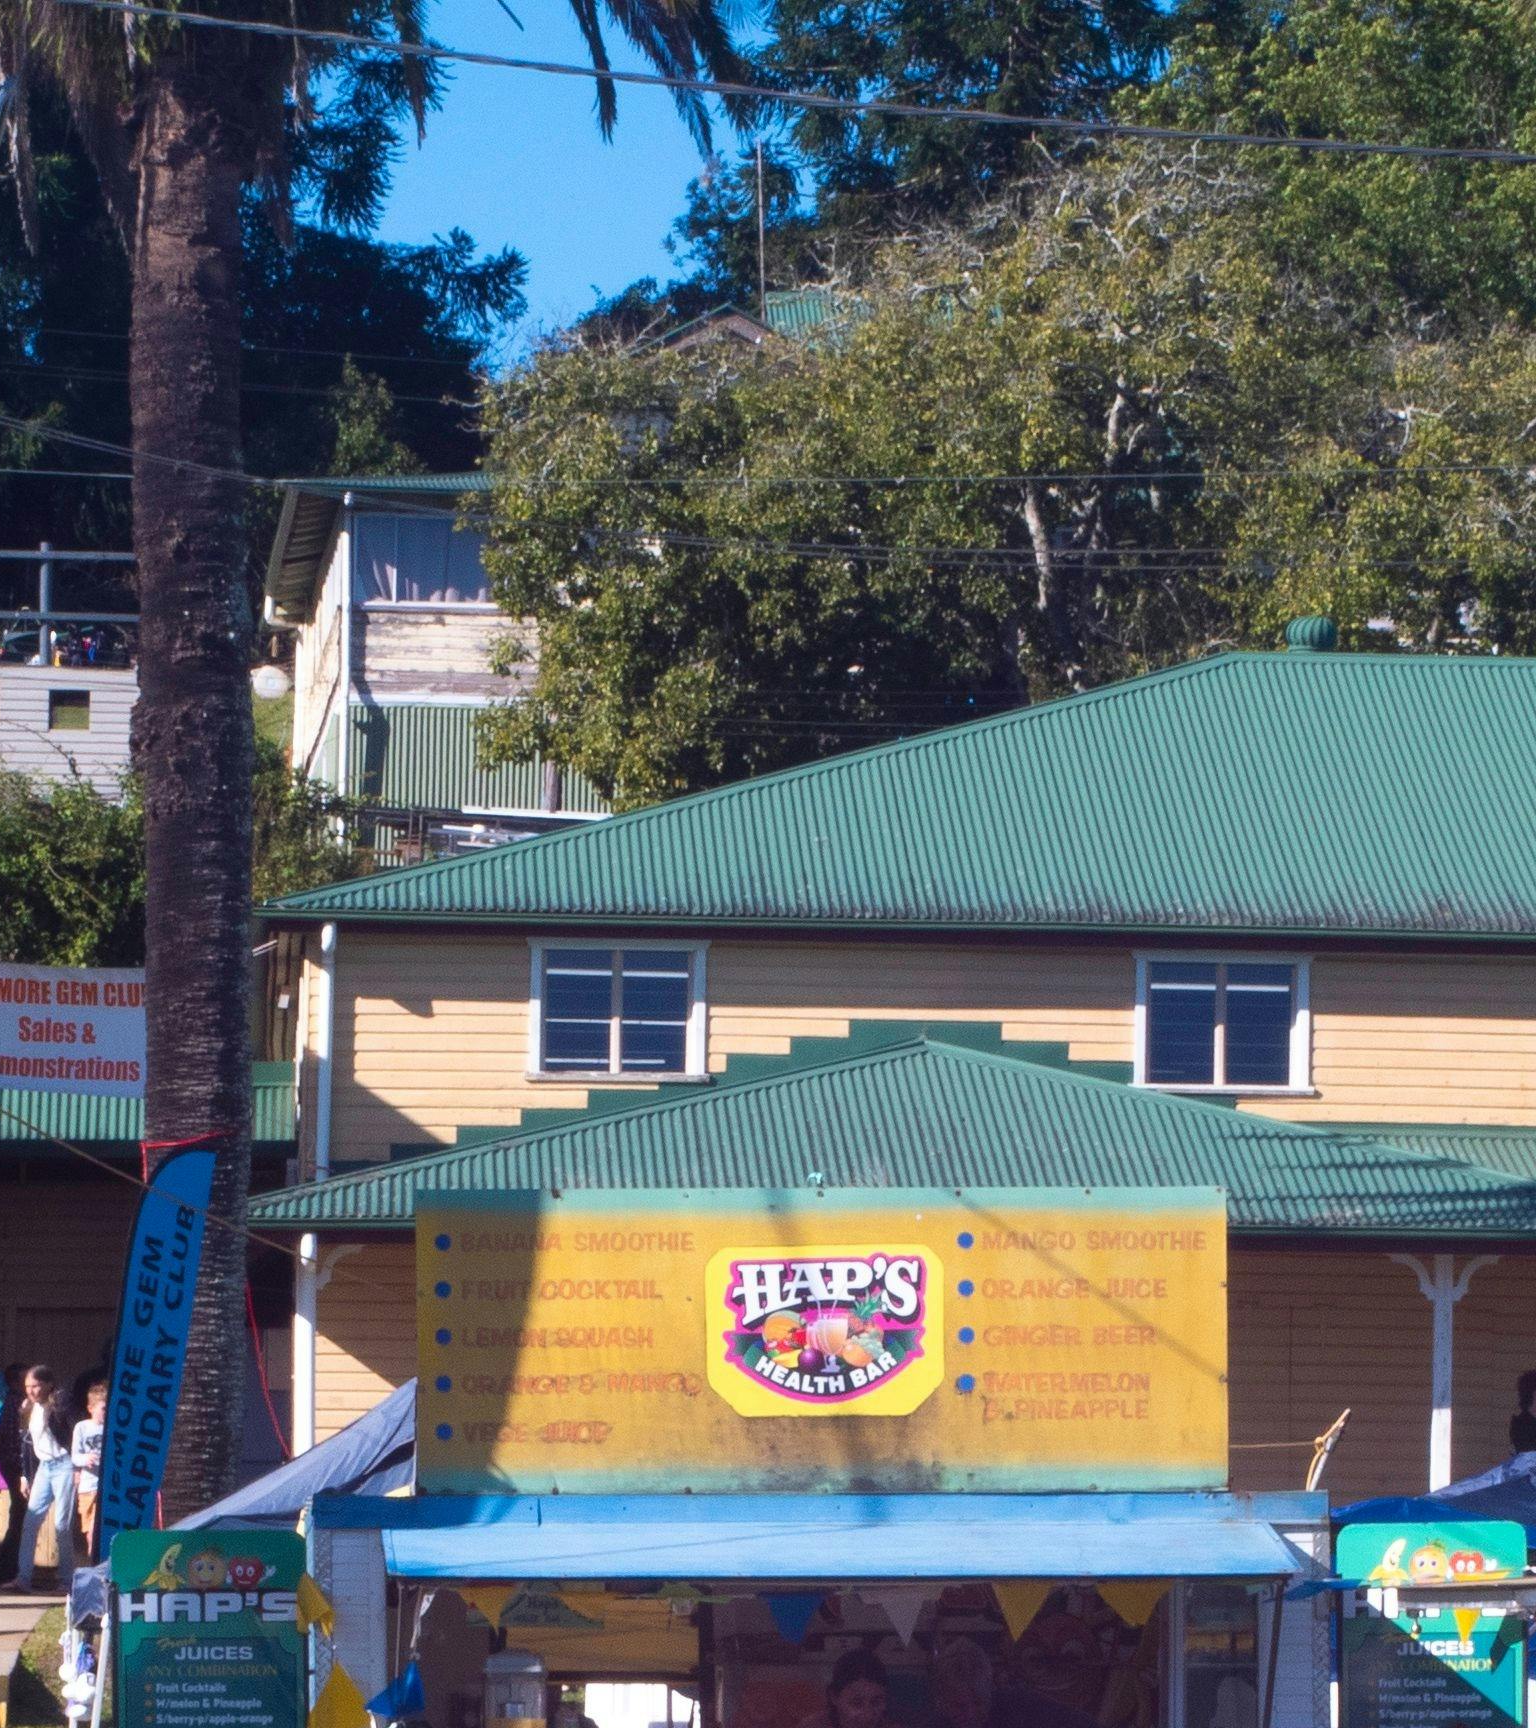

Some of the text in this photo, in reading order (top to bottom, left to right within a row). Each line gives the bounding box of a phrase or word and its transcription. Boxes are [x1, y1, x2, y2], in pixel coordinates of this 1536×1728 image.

[56, 979, 98, 1005] GEM
[104, 982, 147, 1007] CLU
[18, 1015, 96, 1044] Sales &
[574, 1231, 695, 1252] SMOOTHIE
[981, 1229, 1208, 1250] MANGO SMOOTHIE
[165, 1204, 197, 1311] CLUB
[134, 1236, 164, 1327] GEM
[541, 1278, 663, 1301] COCKTAIL
[731, 1256, 920, 1325] HAP'S
[981, 1277, 1168, 1299] ORANGE JUICE
[555, 1326, 654, 1348] SQUASH
[982, 1324, 1158, 1346] GINGER BEER
[755, 1351, 898, 1393] HEALTH BAR
[982, 1372, 1151, 1393] WATERMELON
[607, 1372, 702, 1395] MANGO
[1014, 1399, 1150, 1420] PINEAPPLE
[118, 1592, 297, 1622] HAP'S
[175, 1646, 254, 1660] JUICES
[181, 1664, 279, 1677] COMBINATION
[156, 1683, 227, 1693] Fruit Cocktails
[1379, 1678, 1447, 1688] Fruit Cocktails
[214, 1698, 262, 1711] Pineapple
